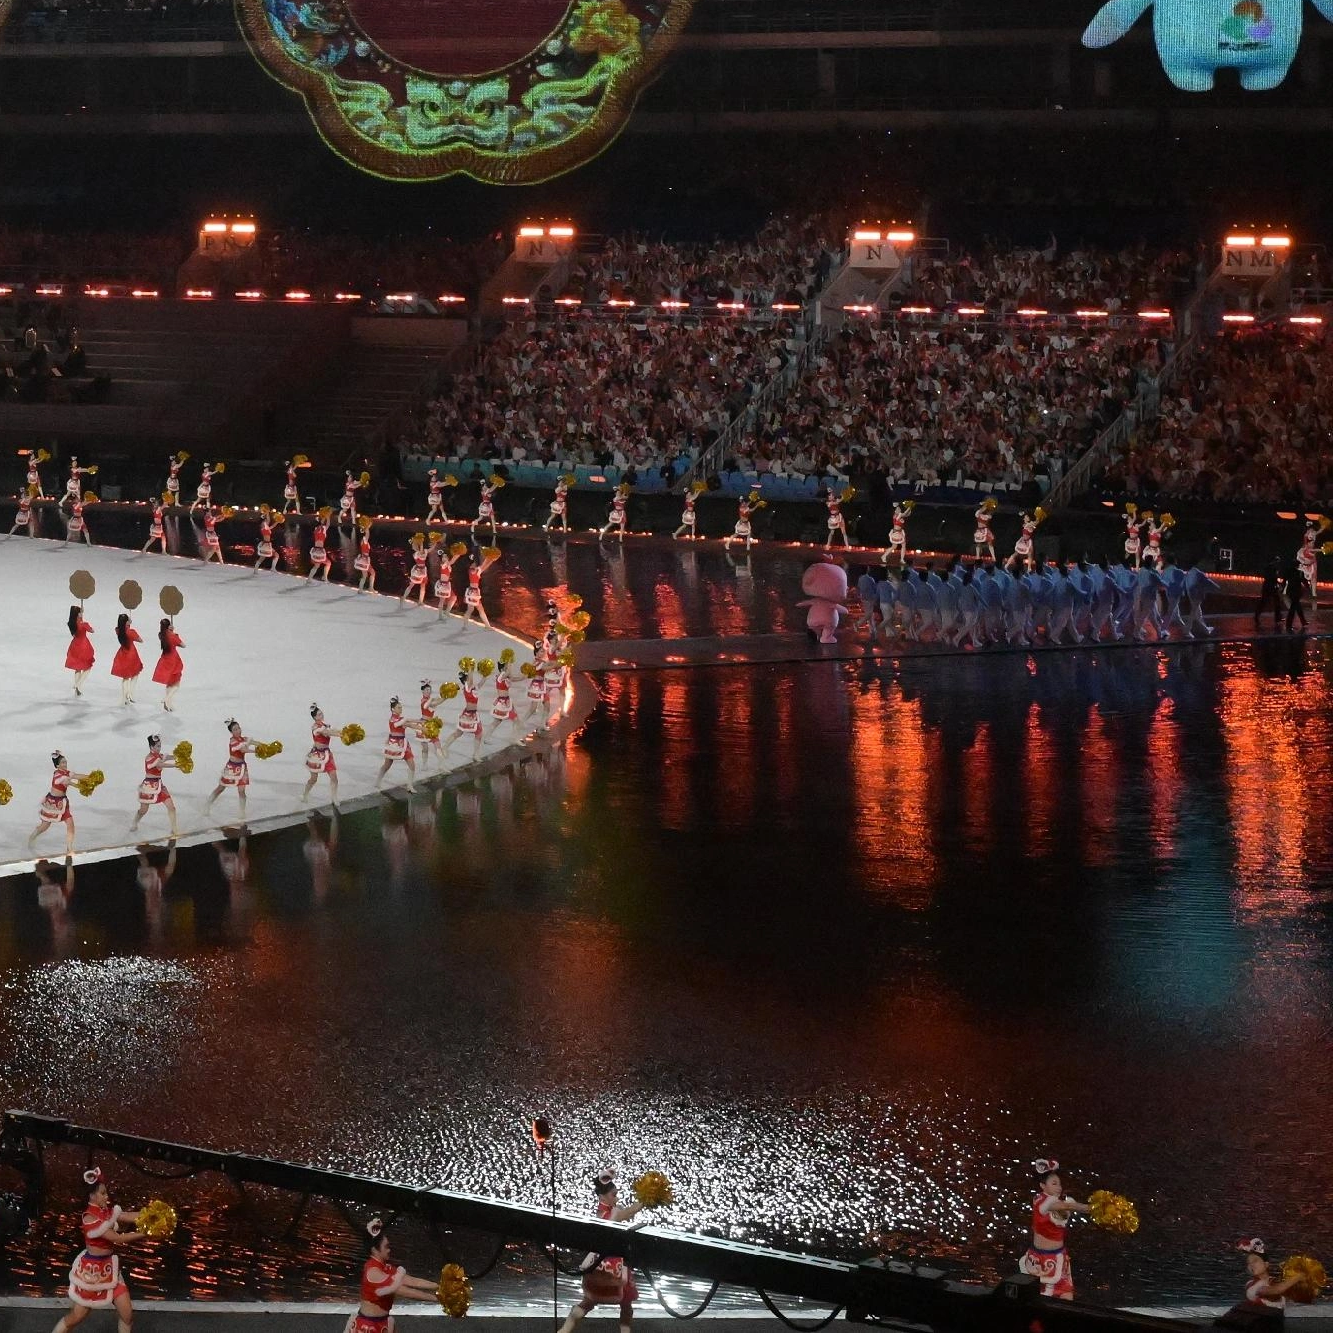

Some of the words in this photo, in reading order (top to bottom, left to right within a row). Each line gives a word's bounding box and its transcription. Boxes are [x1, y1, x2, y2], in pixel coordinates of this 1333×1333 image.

[529, 240, 543, 256] N
[867, 246, 883, 260] N
[1226, 251, 1243, 266] N
[1250, 251, 1273, 266] M
